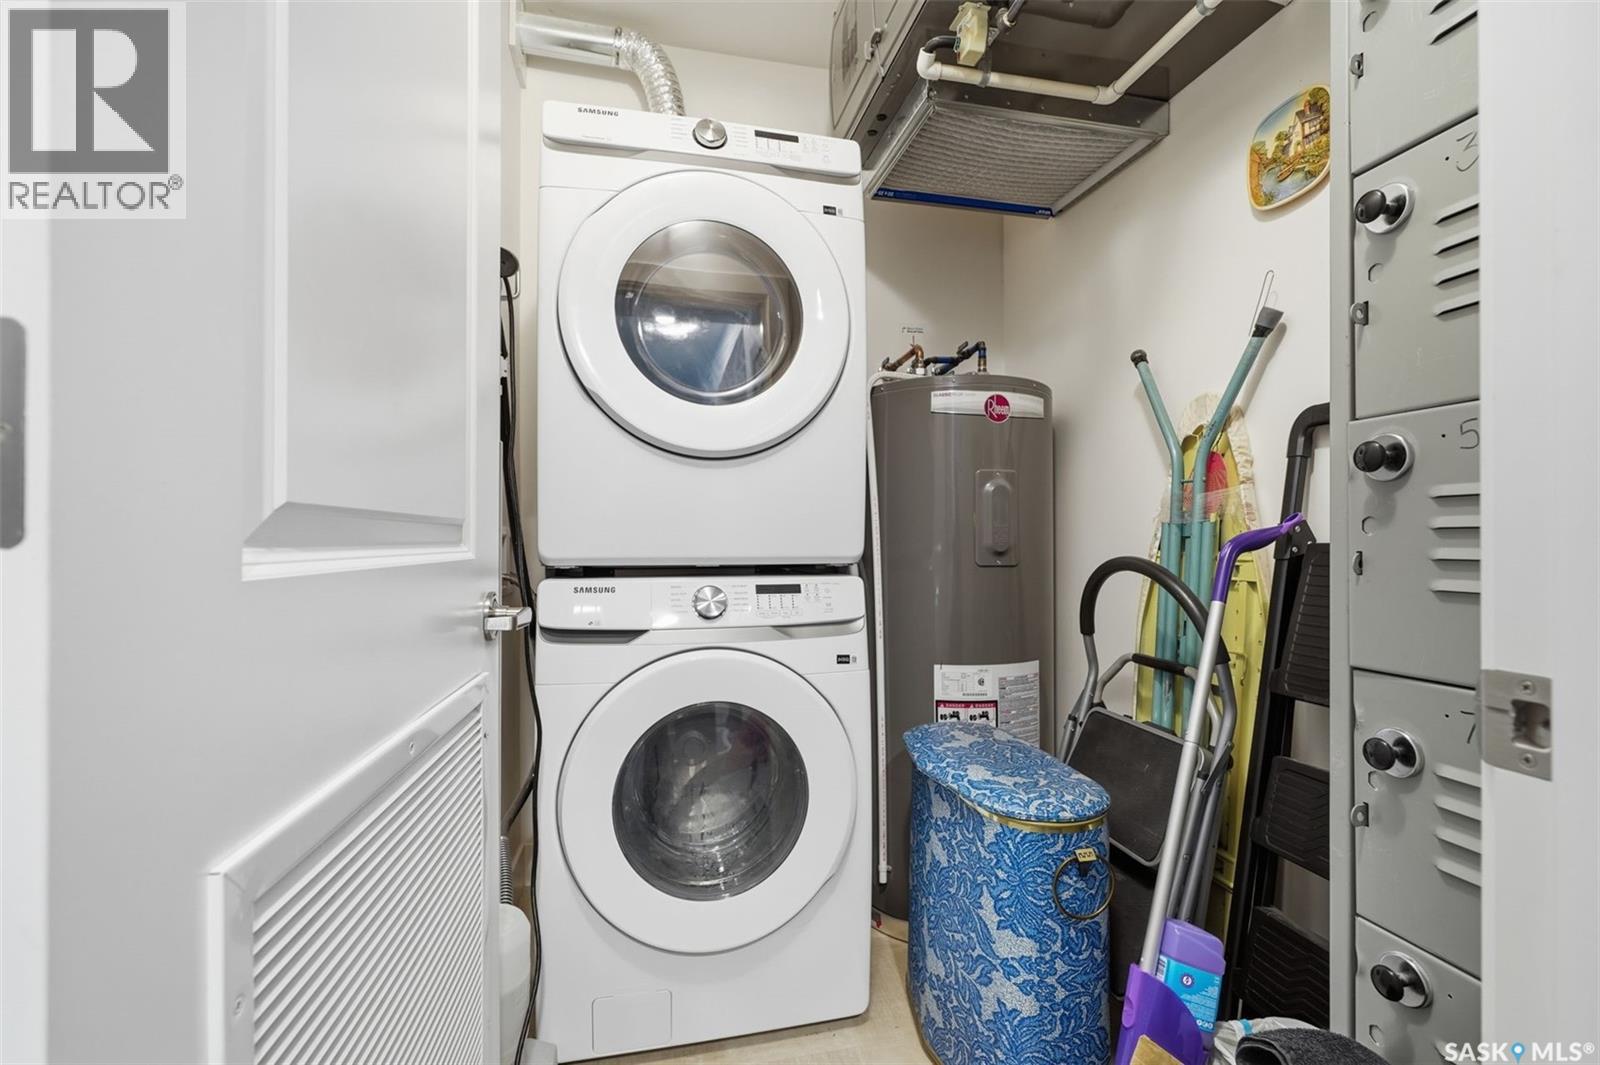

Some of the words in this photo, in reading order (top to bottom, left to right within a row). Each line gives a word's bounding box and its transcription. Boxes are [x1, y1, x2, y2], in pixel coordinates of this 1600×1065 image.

[577, 106, 619, 117] SAMSUNG
[987, 394, 1010, 418] Rheem
[1460, 417, 1480, 450] 5
[573, 586, 616, 594] SAMSUNG
